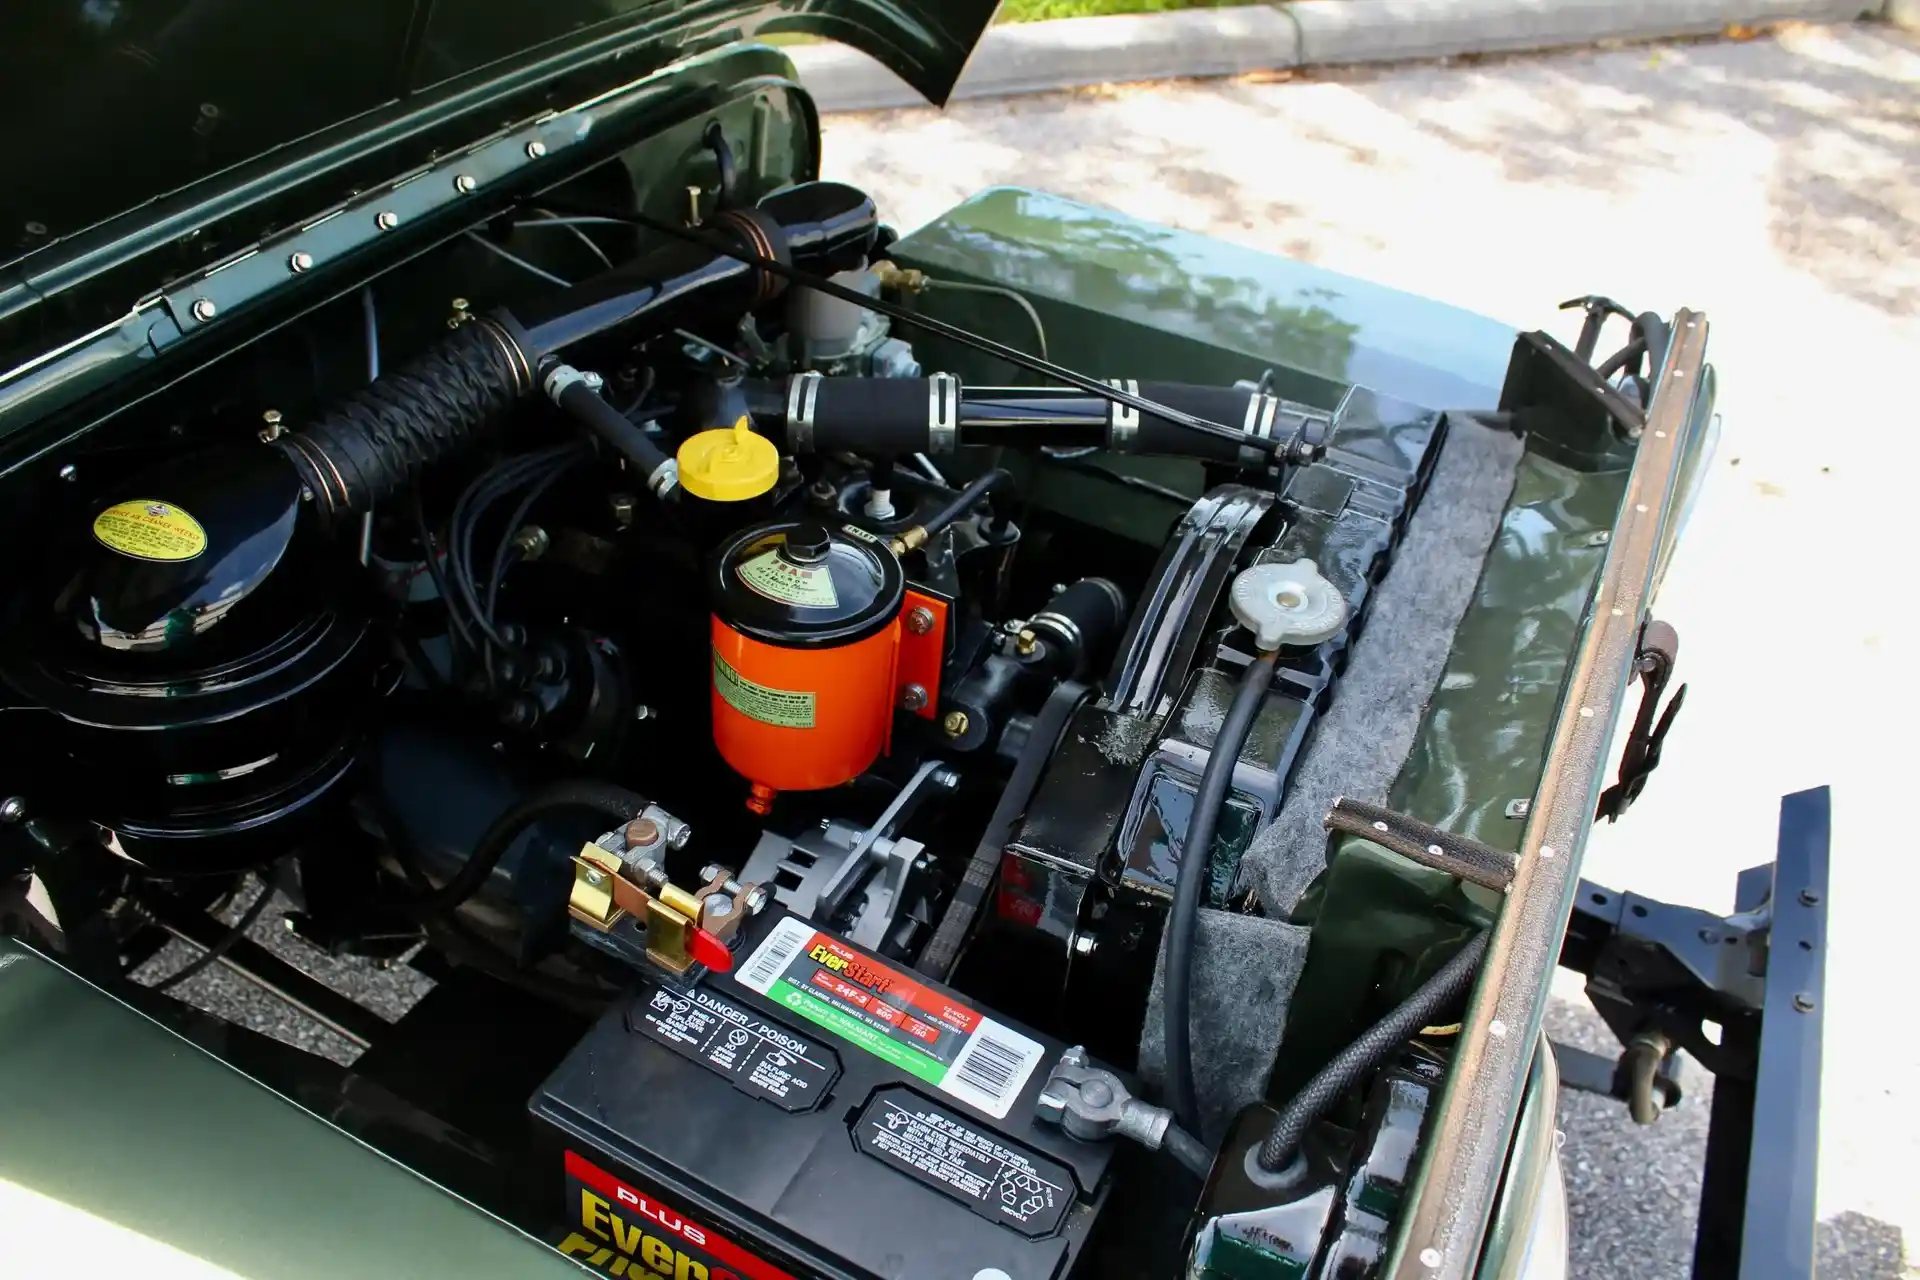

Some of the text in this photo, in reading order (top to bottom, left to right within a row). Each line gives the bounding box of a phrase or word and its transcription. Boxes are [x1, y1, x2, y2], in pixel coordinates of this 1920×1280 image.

[143, 516, 172, 529] CLEANER
[829, 944, 855, 960] PLUS
[808, 943, 894, 994] EverStart
[835, 984, 867, 1003] 24F-3
[665, 1017, 687, 1031] GASES
[670, 1012, 704, 1032] EXPLOSIVE
[688, 1015, 705, 1026] EYES
[692, 1009, 715, 1024] SHIELD
[697, 994, 748, 1024] DANGER
[758, 1025, 806, 1054] POISON
[724, 1042, 736, 1050] NO
[759, 1061, 807, 1088] SULFURIC ACID
[902, 1131, 966, 1166] MEDICAL HELP FAST
[907, 1125, 923, 1137] WITH
[948, 1147, 962, 1157] GET
[909, 1120, 990, 1163] FLUSH EYES IMMEDIATELY
[1021, 1163, 1036, 1175] LEVEL
[617, 1186, 706, 1245] PLUS
[1001, 1205, 1028, 1222] RECYCLE
[581, 1188, 736, 1280] Ever
